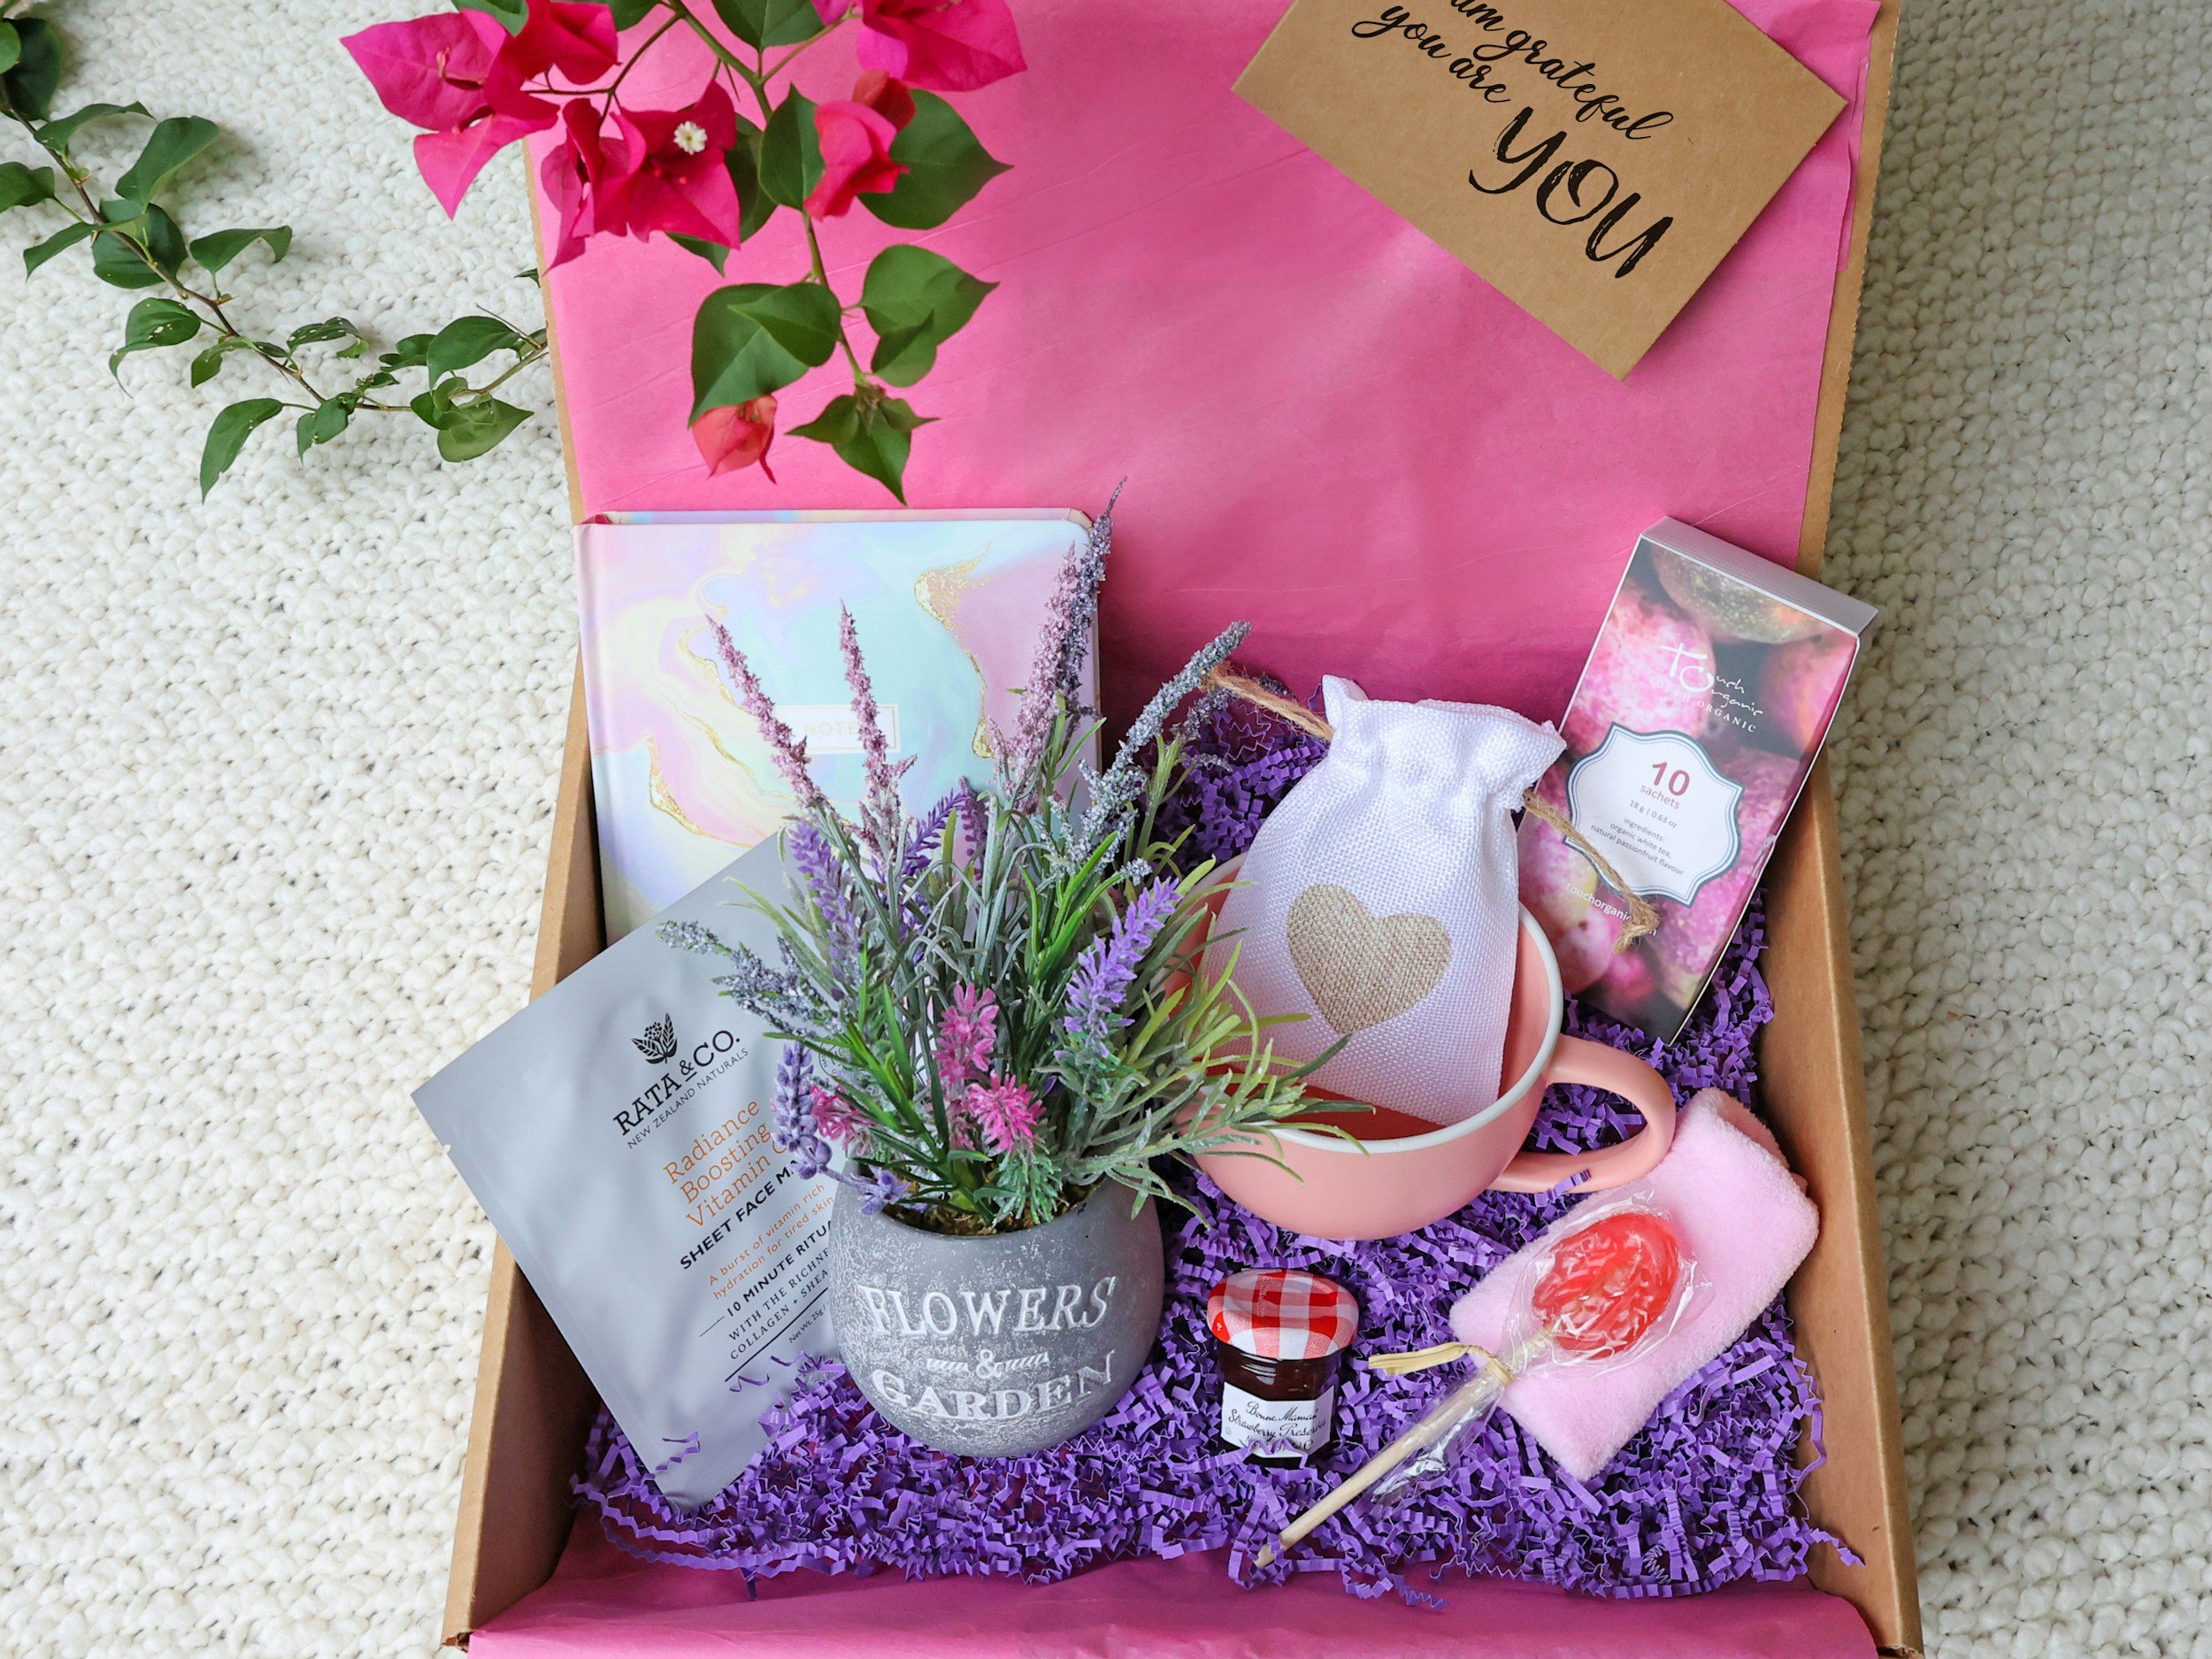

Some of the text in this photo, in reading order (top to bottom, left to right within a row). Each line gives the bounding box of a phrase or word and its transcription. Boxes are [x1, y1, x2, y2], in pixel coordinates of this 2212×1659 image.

[1351, 5, 1511, 103] you are
[1473, 30, 1674, 140] grateful
[1697, 701, 1756, 733] ORGANIC
[1640, 785, 1681, 810] sachets
[1652, 762, 1690, 796] 10
[1591, 824, 1685, 876] natural passionfruit flavour
[1610, 823, 1671, 859] organic white tea,
[1624, 817, 1665, 842] ingredients:
[1651, 810, 1668, 823] 0.63
[1668, 820, 1678, 829] oz
[612, 1030, 741, 1136] RATA & CO.
[627, 1048, 749, 1149] NEW ZEALAND NATURALS
[663, 1101, 761, 1185] Radiance
[680, 1123, 772, 1204] Boosting
[686, 1154, 772, 1227] Vitamin
[680, 1180, 776, 1270] SHEET FACE
[709, 1183, 826, 1286] A burst of vitamin rich
[713, 1196, 834, 1300] hydration for tired skin
[727, 1301, 741, 1317] 10
[742, 1253, 795, 1303] MINUTE
[728, 1310, 762, 1340] WITH
[763, 1287, 788, 1311] THE
[730, 1304, 790, 1360] COLLAGEN
[801, 1269, 828, 1298] SHEA
[858, 1276, 1117, 1336] FLOWERS
[788, 1330, 802, 1344] Net
[975, 1348, 1003, 1379] &
[872, 1349, 1115, 1420] GARDEN
[1245, 1401, 1277, 1422] Bonne
[1228, 1409, 1277, 1441] Strawberry
